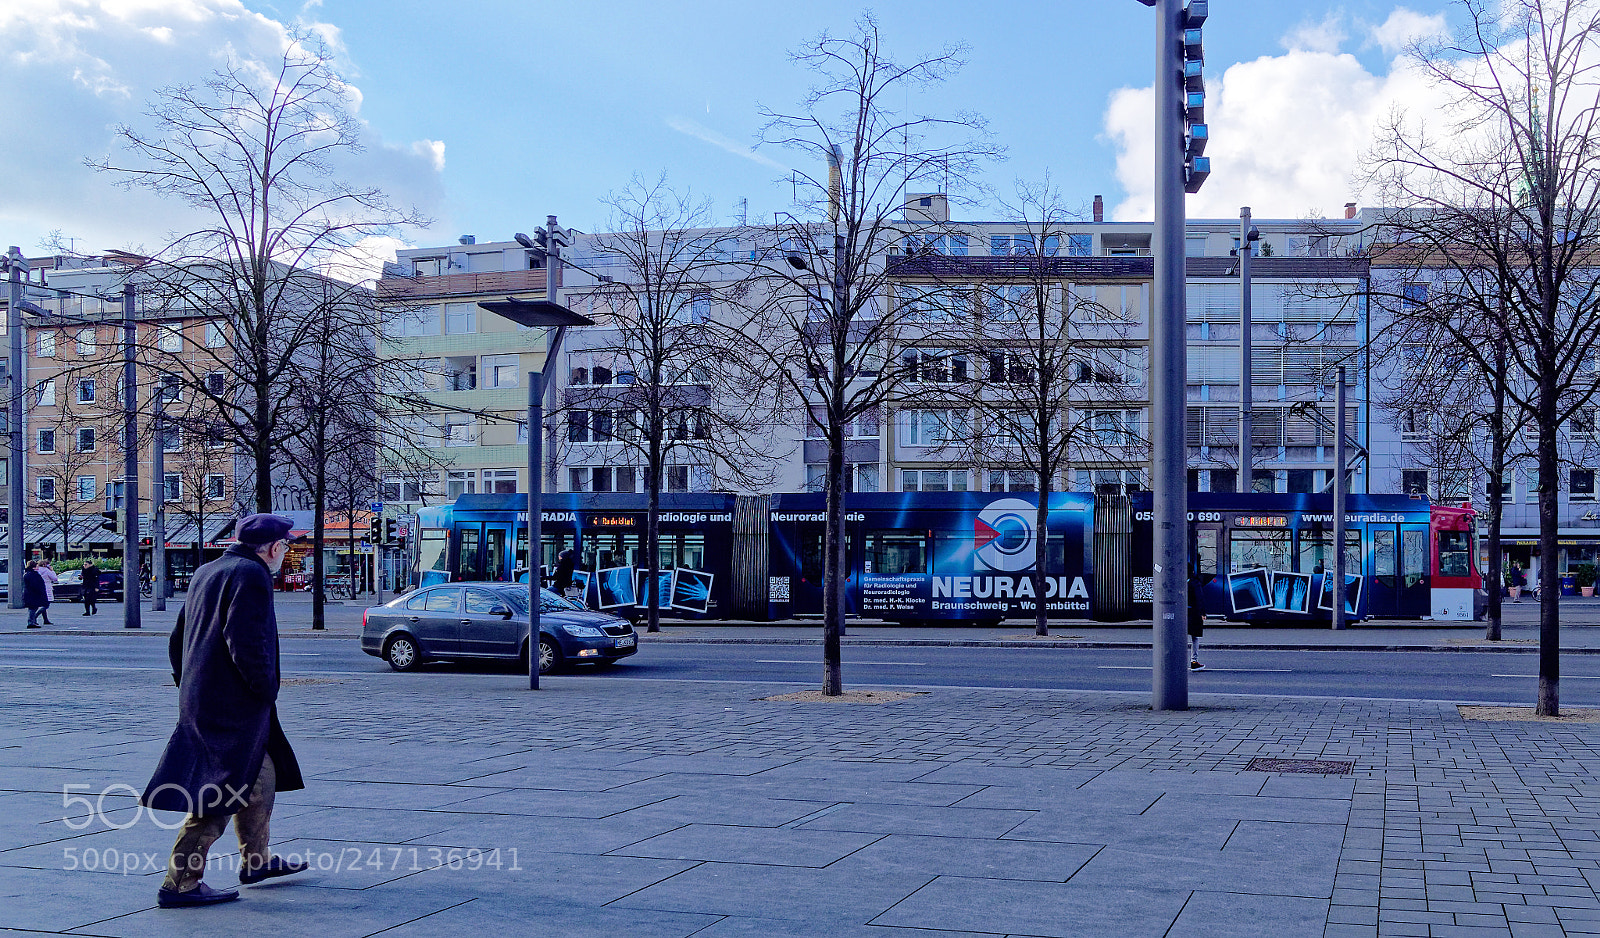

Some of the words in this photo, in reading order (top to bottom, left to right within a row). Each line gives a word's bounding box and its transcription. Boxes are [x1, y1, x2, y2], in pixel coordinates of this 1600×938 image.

[517, 512, 577, 522] NERADIA
[657, 512, 707, 523] adiologie
[710, 512, 732, 522] und
[1198, 511, 1221, 521] 690
[1301, 513, 1405, 523] www.euradia.de
[932, 576, 1089, 599] NEURADIA
[931, 601, 1008, 611] Braunschweig
[1020, 601, 1089, 611] Woenbüttel
